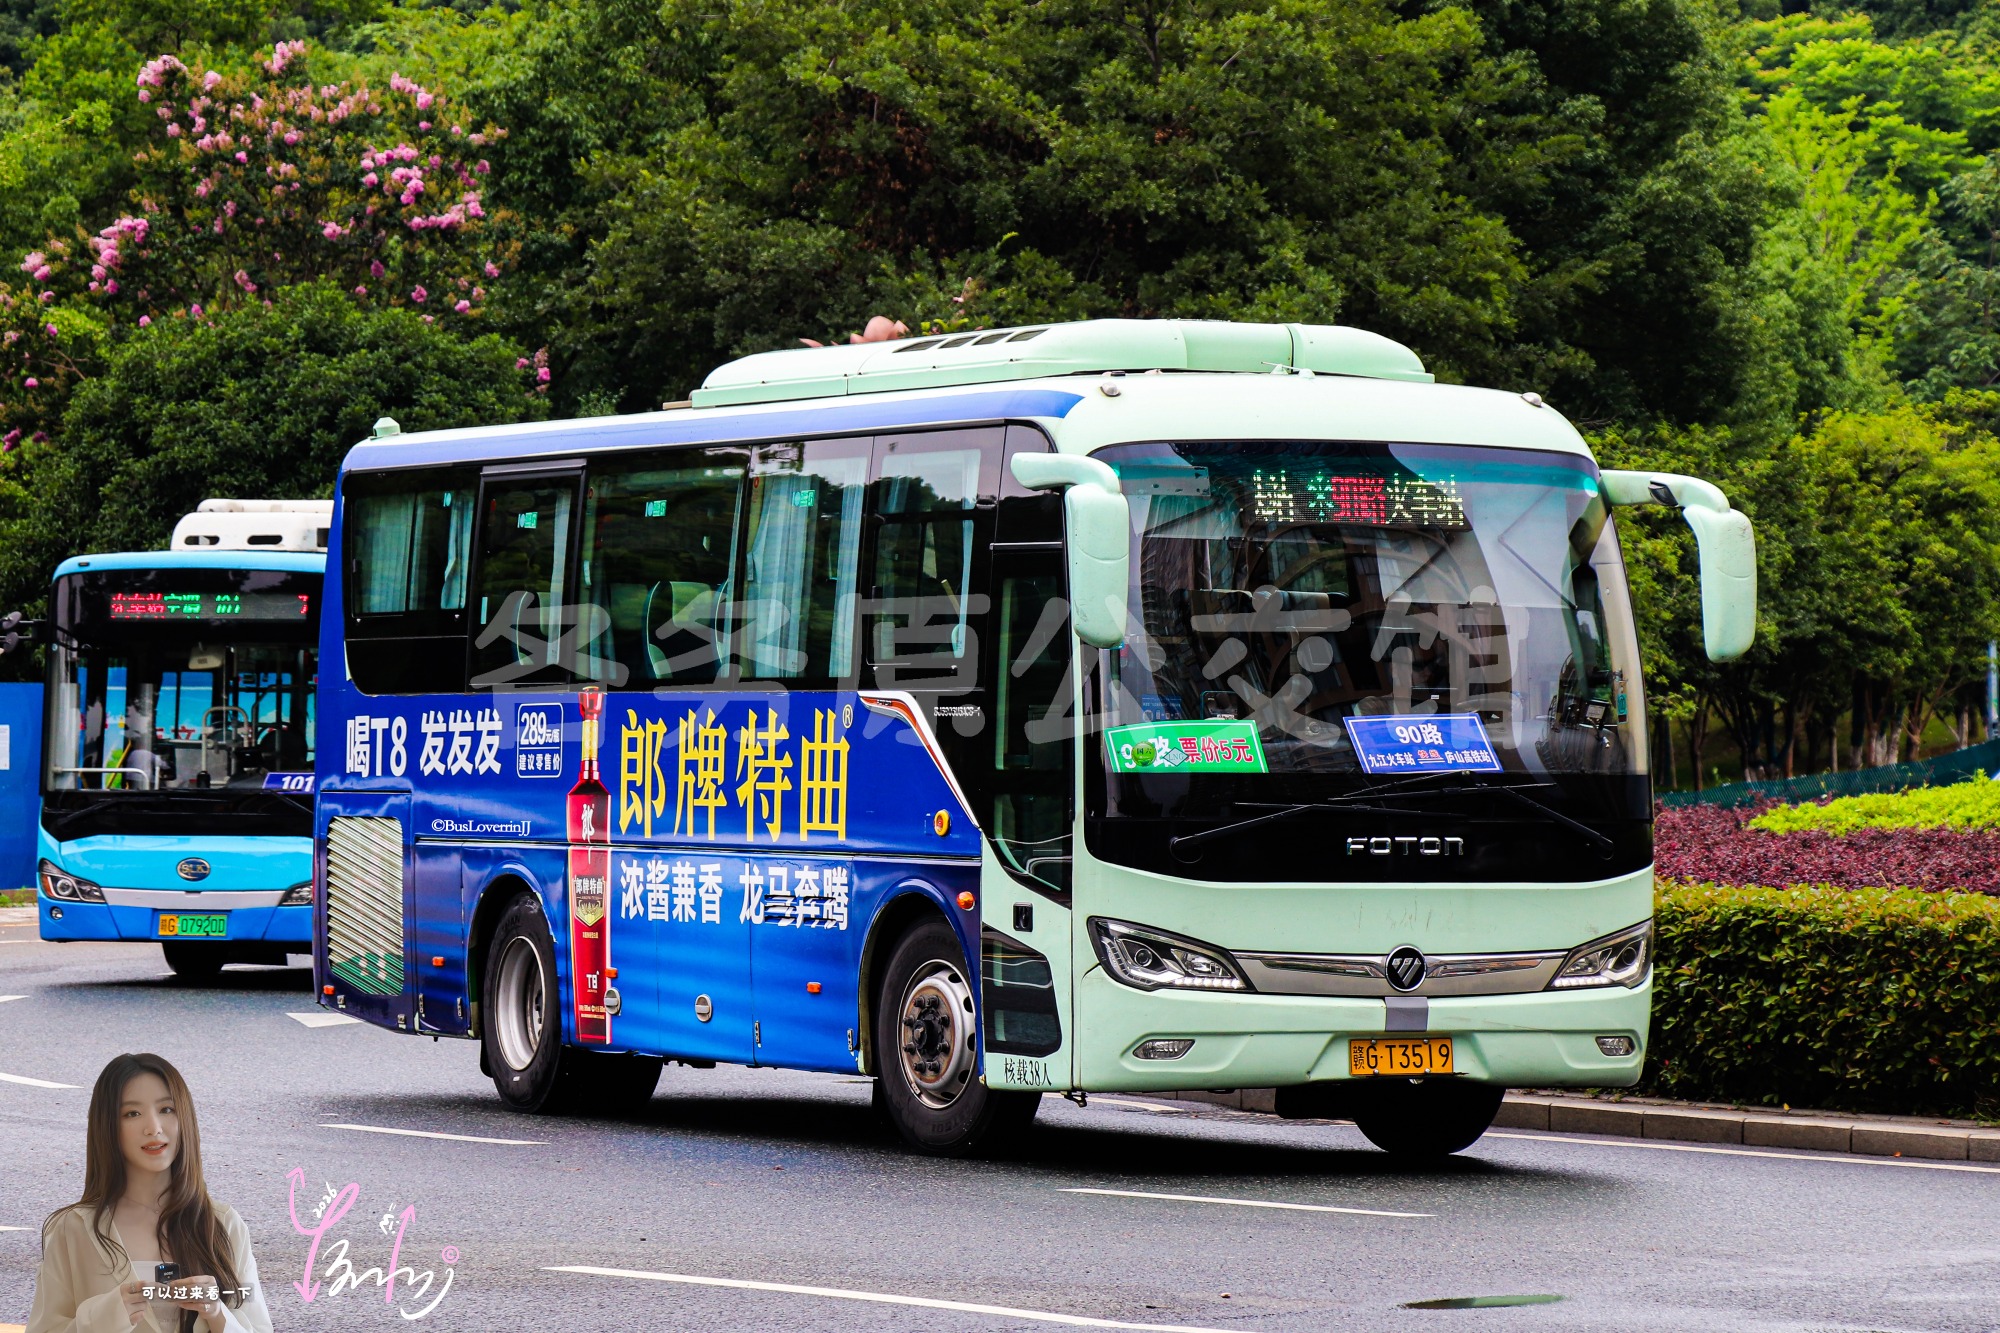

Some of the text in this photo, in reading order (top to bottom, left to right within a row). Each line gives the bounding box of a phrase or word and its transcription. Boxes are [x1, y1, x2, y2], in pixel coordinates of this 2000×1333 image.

[346, 708, 503, 778] 喝T8 发发发
[1395, 723, 1444, 745] 90路
[518, 752, 561, 771] 建议零售价
[1177, 736, 1254, 763] 票价5元
[1368, 751, 1416, 768] 九江火车站
[1444, 749, 1492, 764] 庐山高铁站
[1346, 836, 1464, 856] FOTON
[619, 859, 850, 931] 浓酱兼香 龙马奔腾
[1004, 1057, 1052, 1087] 核载38人
